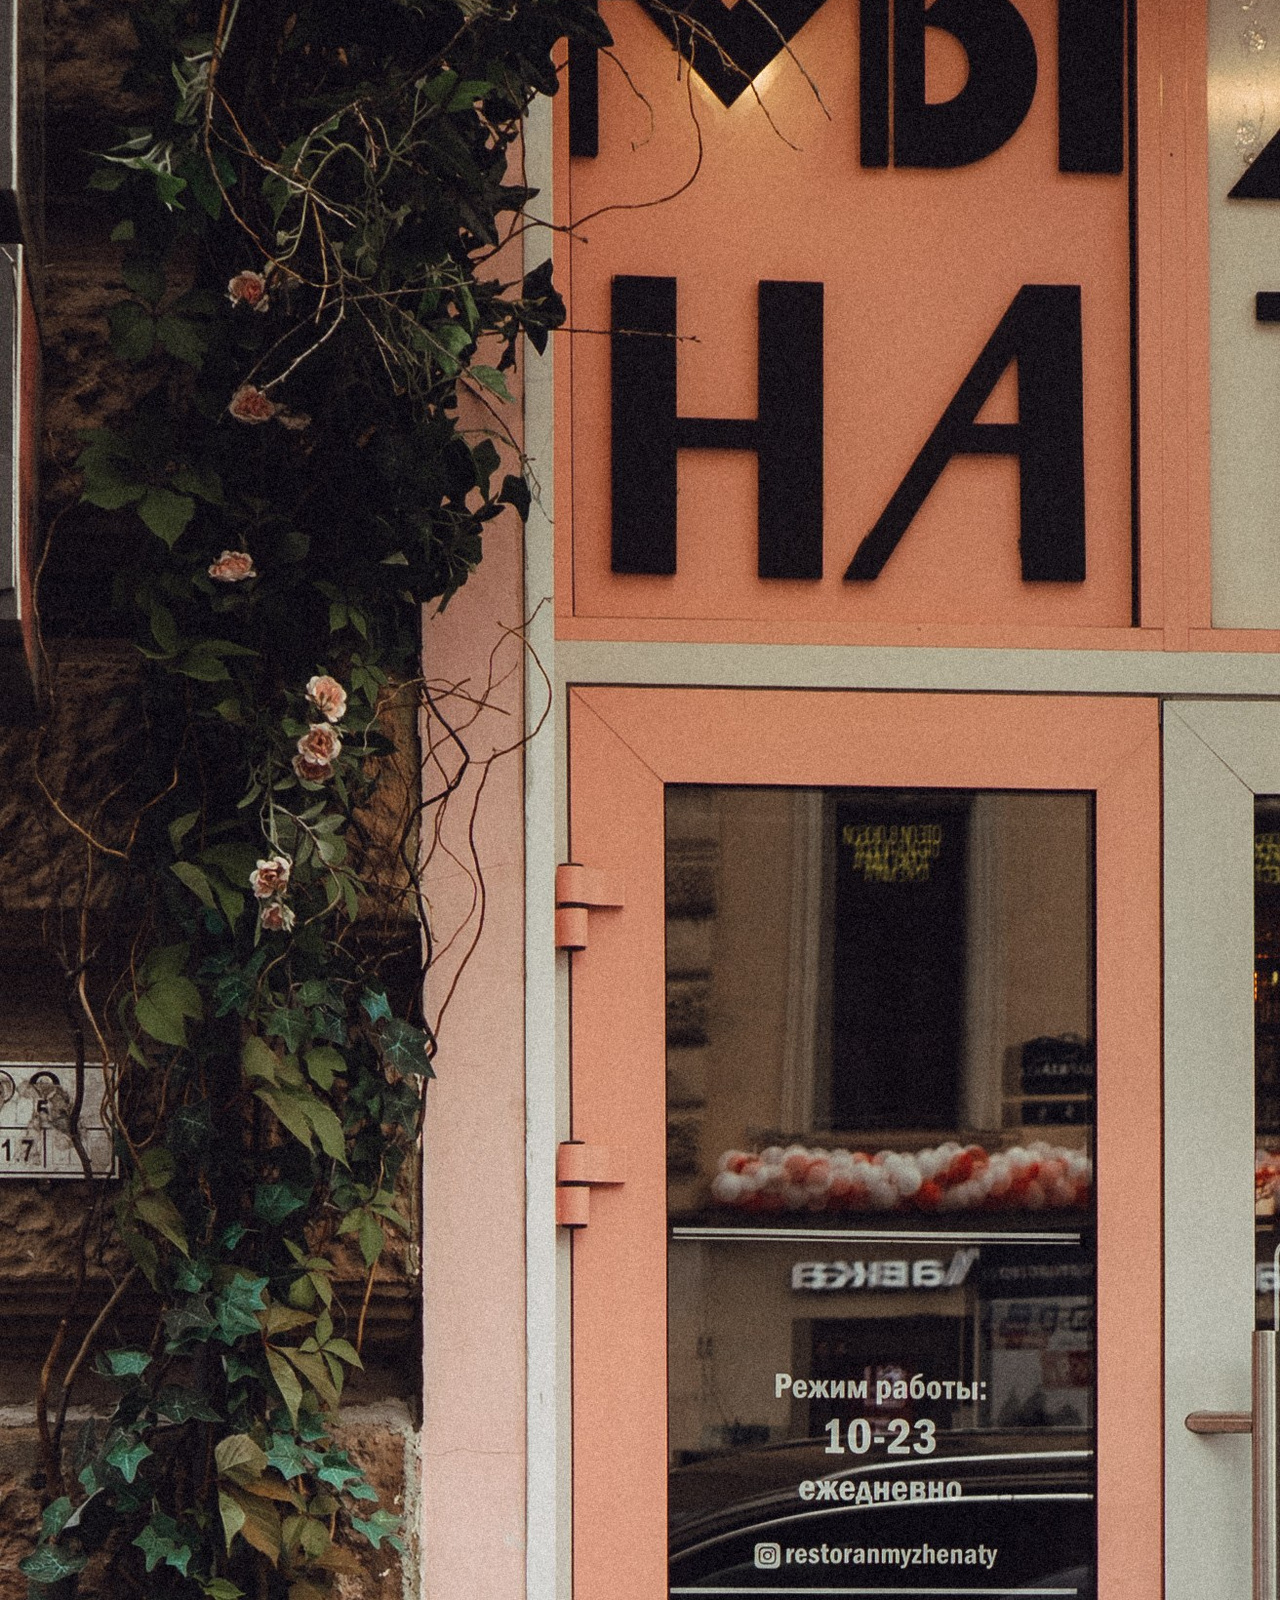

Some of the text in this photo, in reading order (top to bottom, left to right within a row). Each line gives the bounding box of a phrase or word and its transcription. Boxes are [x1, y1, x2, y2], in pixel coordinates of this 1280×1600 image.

[611, 275, 1085, 582] НА
[775, 1373, 988, 1405] Режим работы:
[824, 1418, 937, 1454] 10-23
[798, 1480, 962, 1505] ежедневно
[785, 1543, 998, 1570] restoranmyzhenaty
